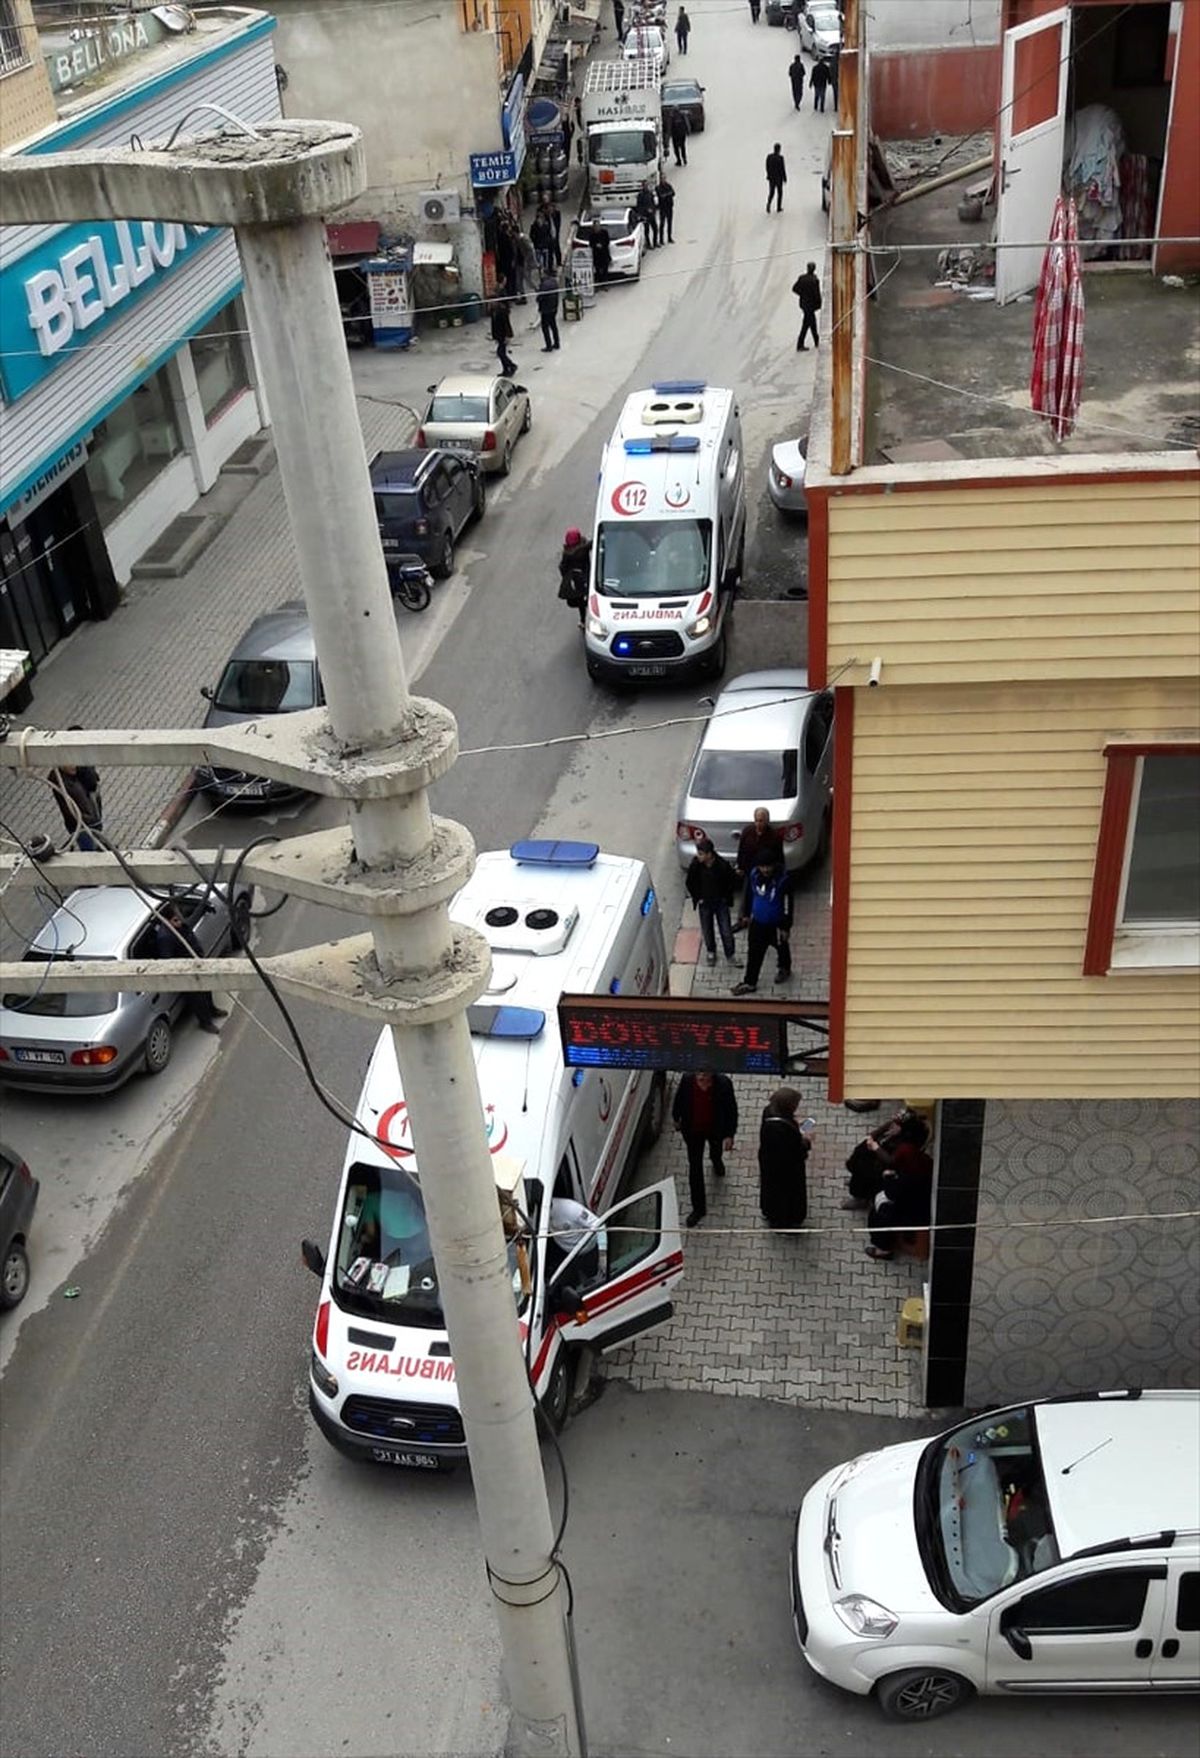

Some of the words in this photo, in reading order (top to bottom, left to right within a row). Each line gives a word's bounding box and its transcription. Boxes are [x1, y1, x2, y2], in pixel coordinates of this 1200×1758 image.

[56, 22, 149, 83] BELLONA
[472, 154, 513, 168] TEMİZ
[478, 168, 510, 181] BÜFE
[24, 220, 209, 356] BELLO
[625, 488, 647, 507] 112
